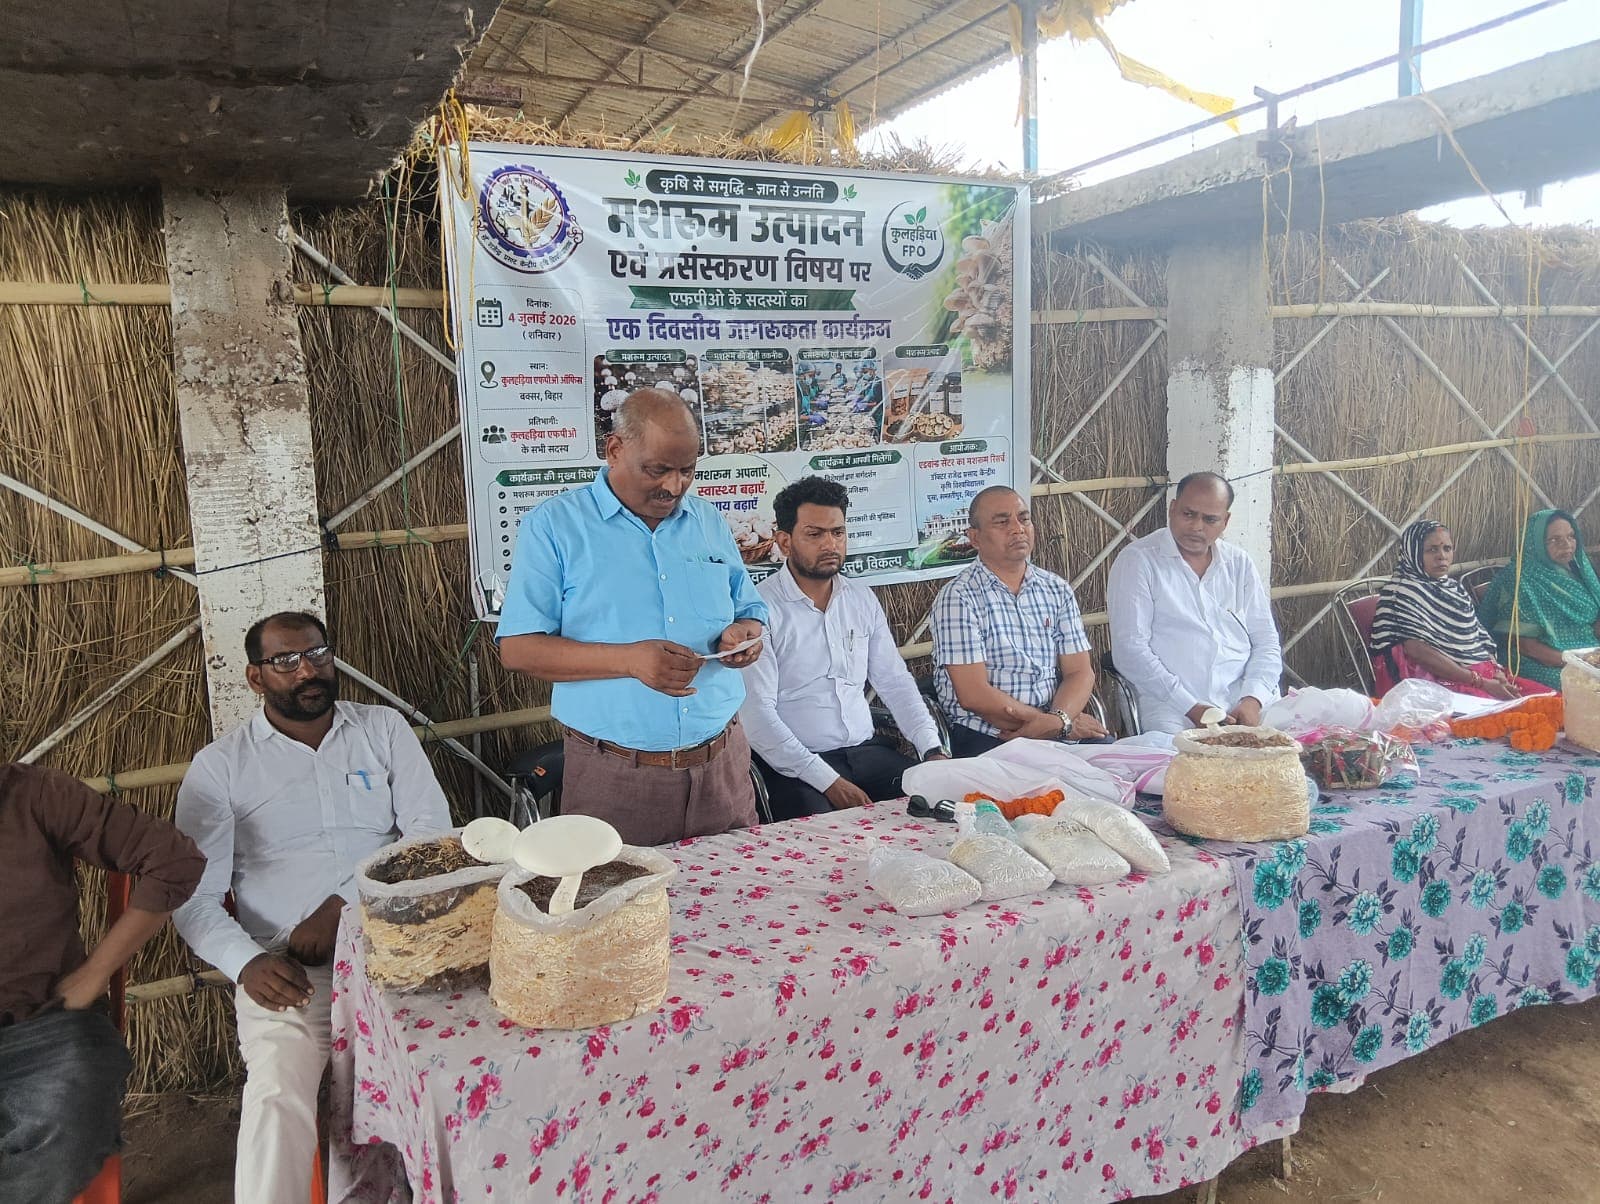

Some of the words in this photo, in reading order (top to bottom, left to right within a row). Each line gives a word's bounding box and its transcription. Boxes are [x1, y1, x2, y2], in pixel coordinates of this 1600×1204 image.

[660, 175, 689, 193] कृषि
[693, 176, 704, 191] से
[708, 178, 744, 196] समृद्धि
[756, 182, 777, 197] ज्ञान
[779, 181, 790, 196] से
[793, 183, 825, 199] उन्नति
[602, 197, 741, 241] मशरूम
[748, 205, 866, 246] उत्पादन
[902, 245, 926, 257] FPO
[608, 243, 648, 279] एवं
[655, 244, 778, 281] प्रसंस्करण
[784, 248, 845, 283] विषय
[850, 261, 872, 283] पर
[670, 289, 724, 307] एफपीओ
[728, 289, 742, 306] के
[746, 289, 787, 308] सदस्यों
[791, 293, 808, 308] का
[508, 313, 515, 323] 4
[518, 311, 546, 326] जुलाई
[549, 314, 576, 325] 2026
[607, 318, 641, 340] एक
[646, 312, 721, 341] दिवसीय
[822, 312, 892, 341] कार्यक्रम
[545, 390, 563, 401] बिहार
[548, 428, 577, 439] एफपीओ
[521, 443, 529, 454] के
[531, 443, 546, 454] सभी
[548, 444, 569, 454] सदस्य
[509, 471, 541, 483] कार्यक्रम
[543, 470, 555, 481] की
[558, 471, 576, 483] मुख्य
[695, 469, 732, 480] मशरूम
[697, 484, 738, 497] स्वास्थ्य
[866, 556, 903, 570] विकल्प
